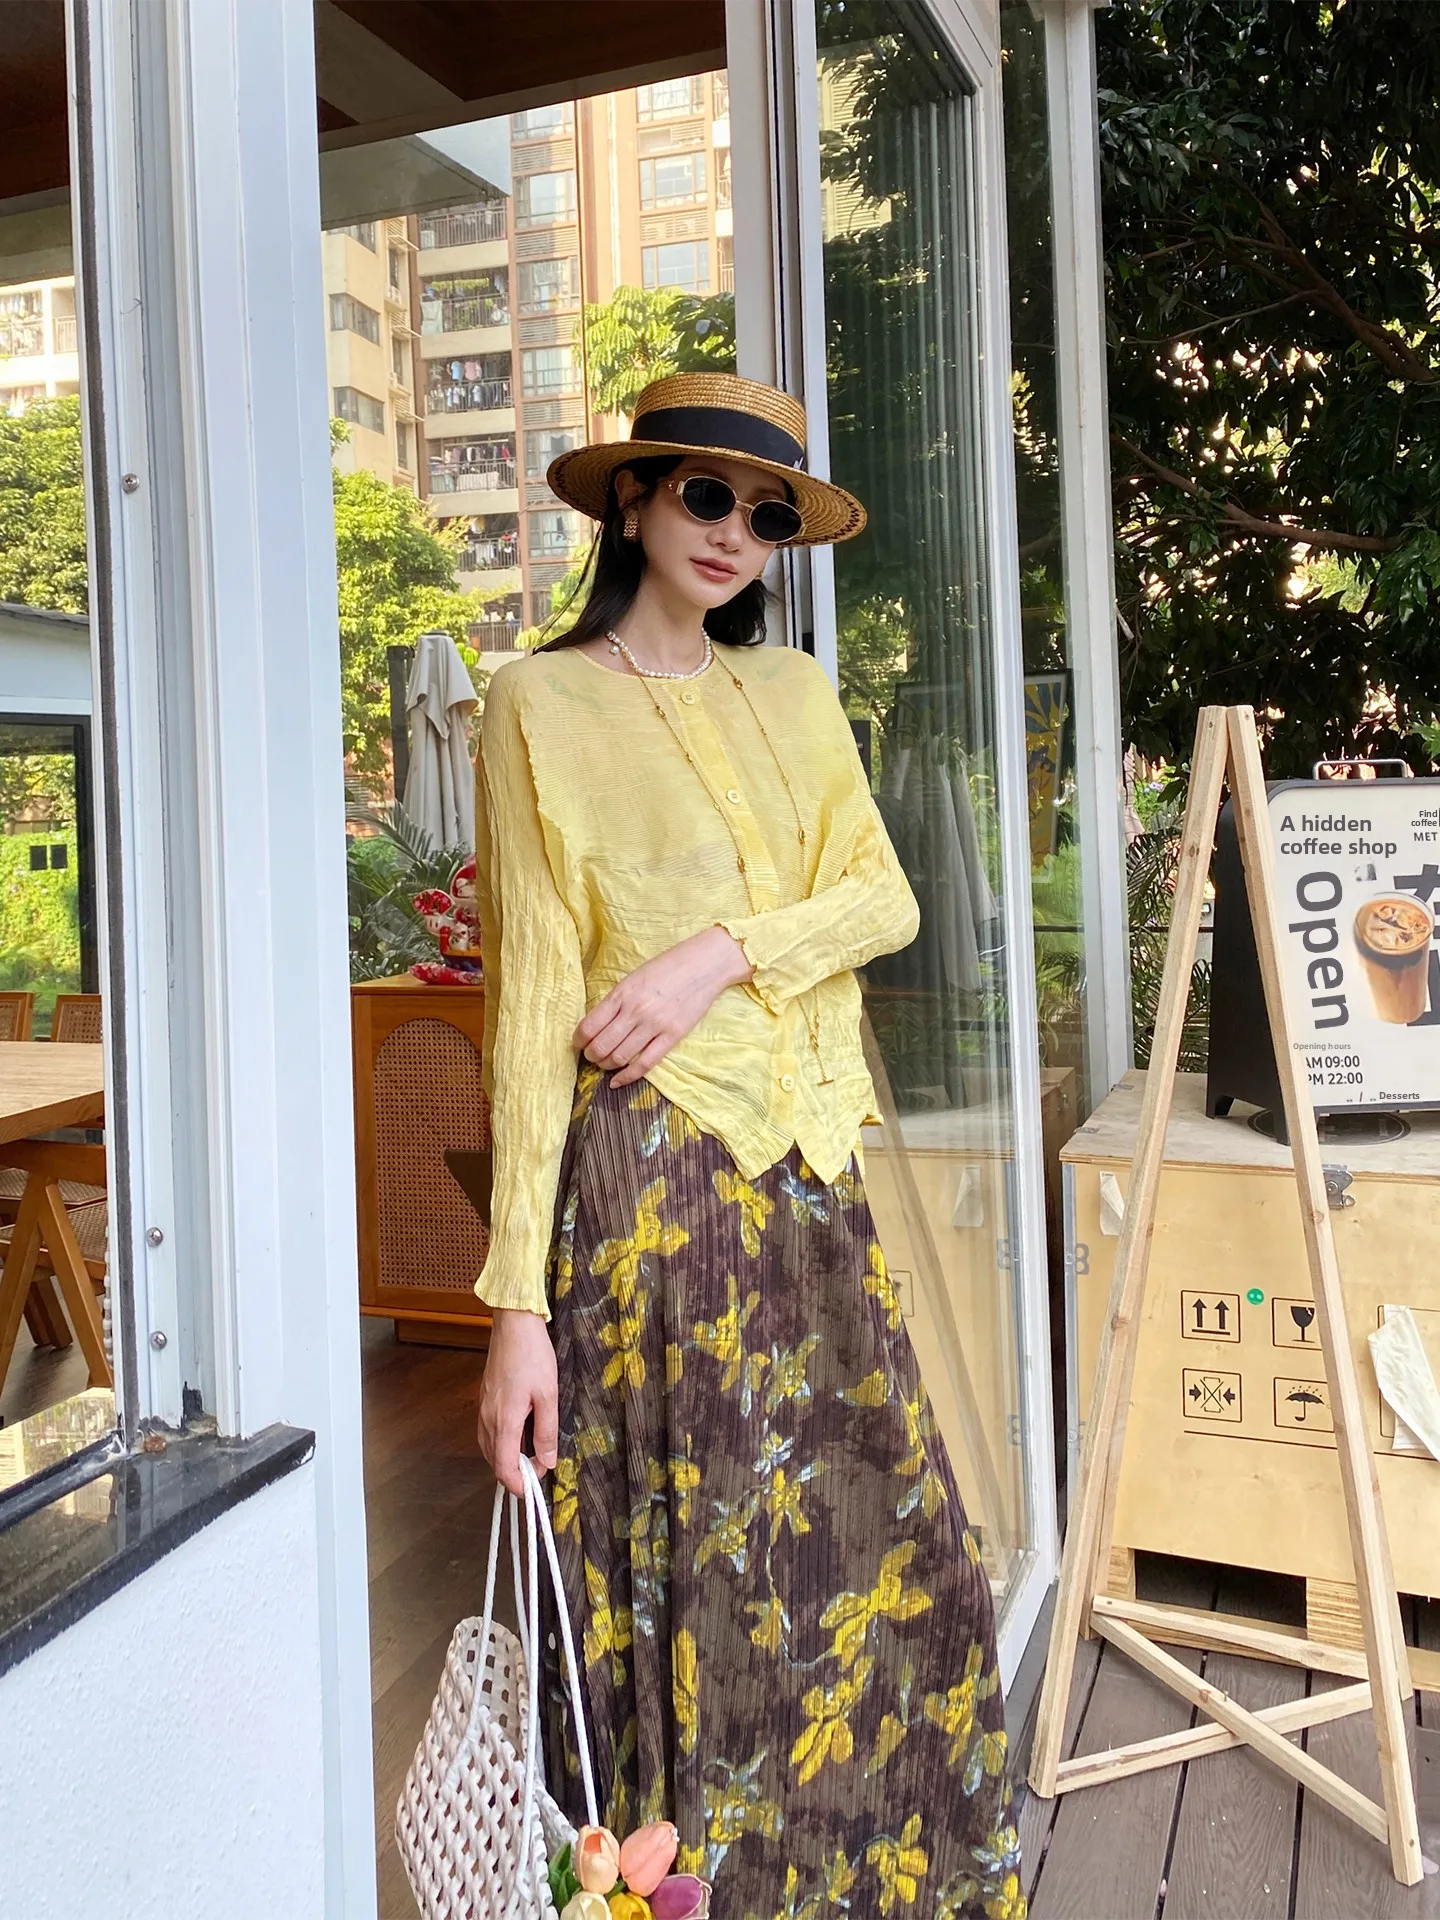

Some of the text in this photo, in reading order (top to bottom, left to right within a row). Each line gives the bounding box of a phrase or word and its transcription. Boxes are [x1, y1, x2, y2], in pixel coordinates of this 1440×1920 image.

[1419, 810, 1438, 818] Find
[1280, 815, 1372, 832] A hidden
[1411, 819, 1438, 827] coffee
[1414, 832, 1438, 841] MET
[1280, 838, 1397, 858] coffee shop
[1288, 871, 1350, 1030] Open
[1293, 1043, 1326, 1051] Opening
[1325, 1055, 1360, 1069] 09:00
[1328, 1072, 1363, 1085] 22:00
[1379, 1091, 1420, 1100] Desserts
